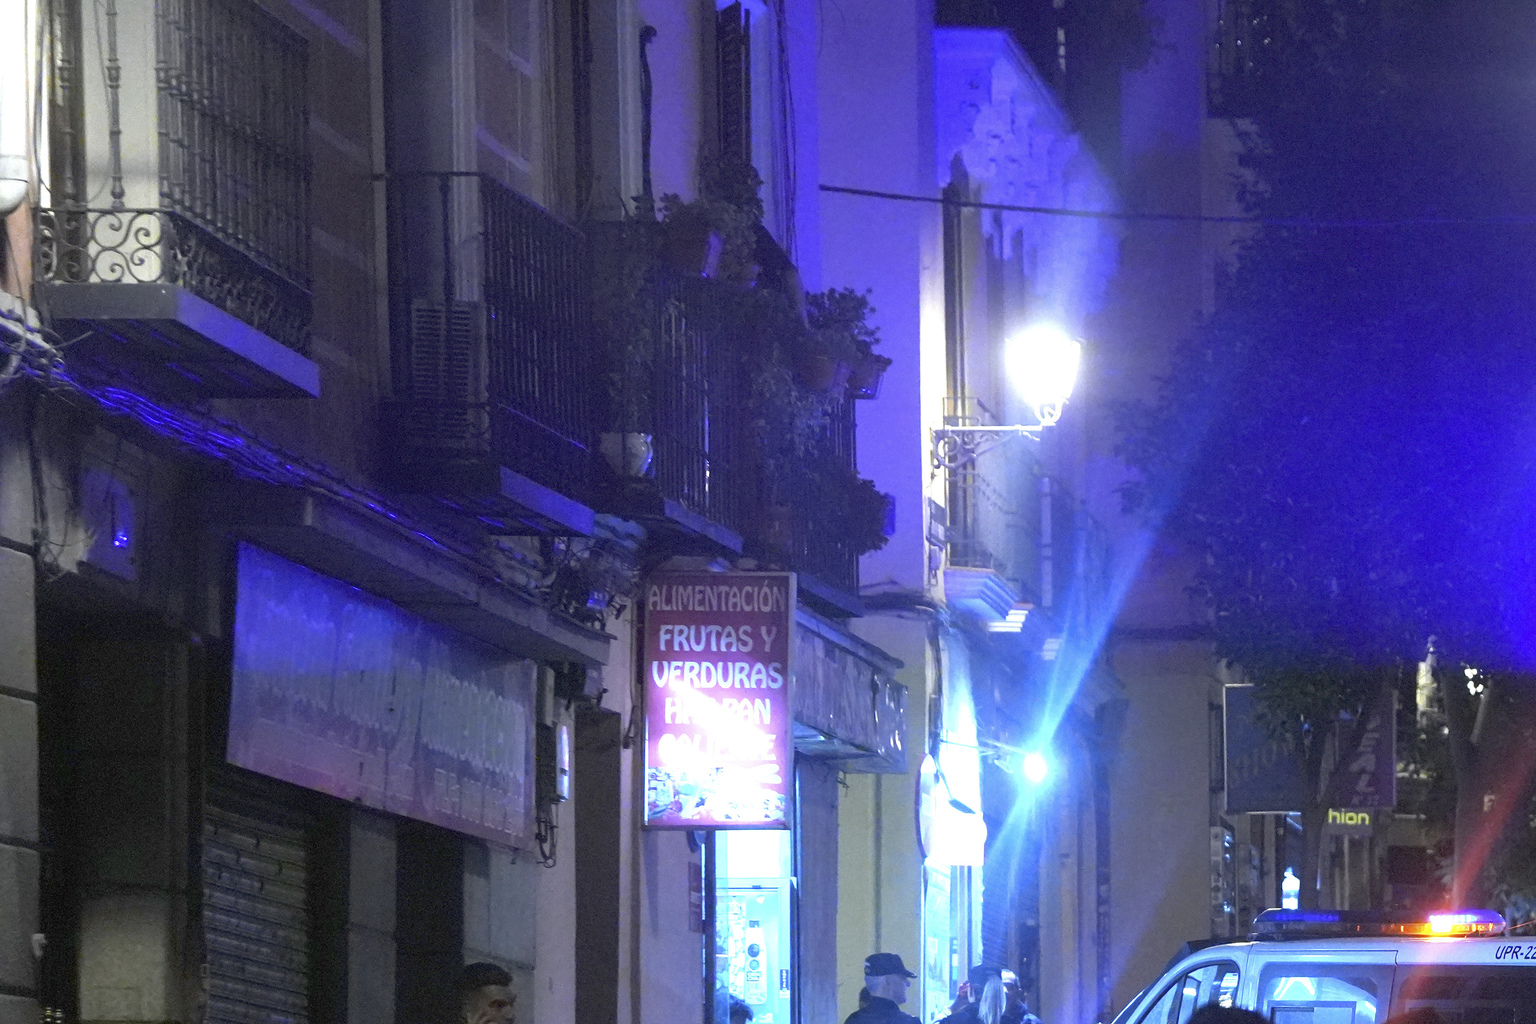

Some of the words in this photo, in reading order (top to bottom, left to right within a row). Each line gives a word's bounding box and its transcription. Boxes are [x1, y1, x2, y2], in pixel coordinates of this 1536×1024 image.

[649, 579, 786, 613] ALIMENTACIÓN
[659, 624, 753, 653] FRUTAS
[760, 625, 777, 653] Y
[652, 660, 783, 689] VERDURAS
